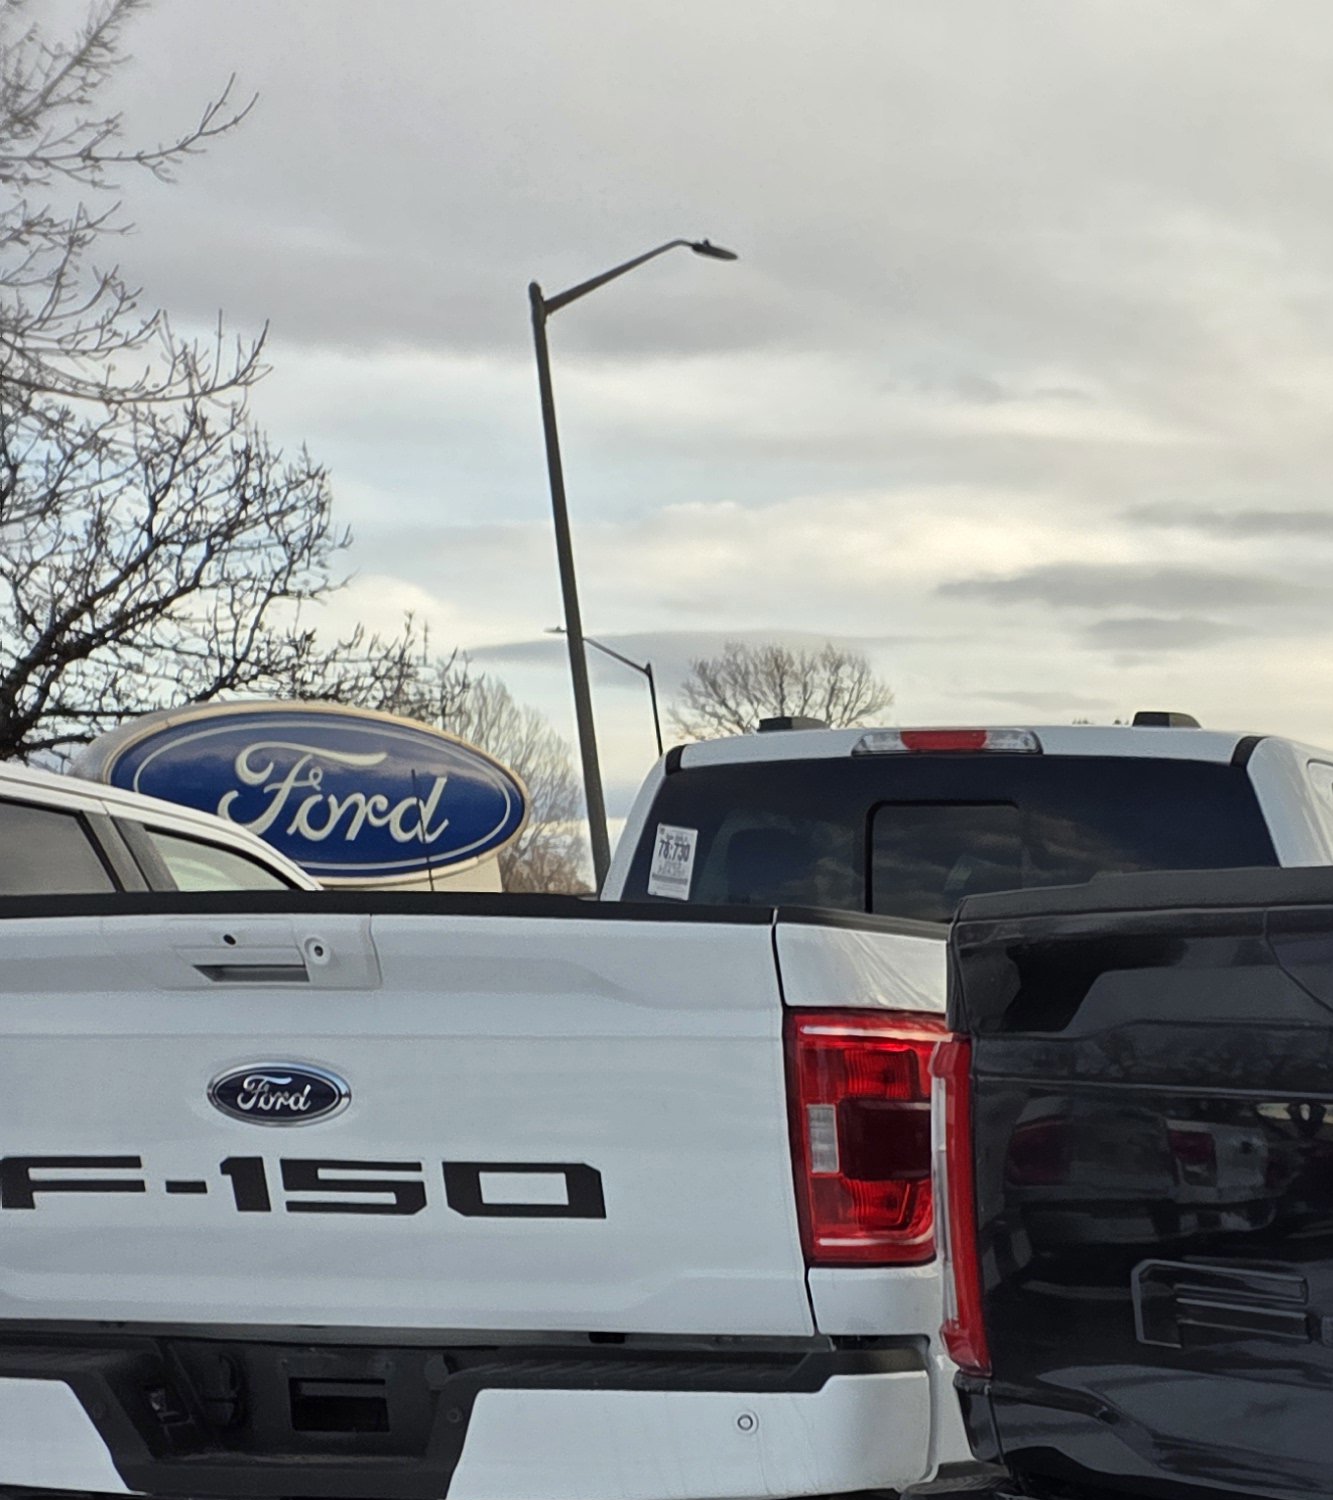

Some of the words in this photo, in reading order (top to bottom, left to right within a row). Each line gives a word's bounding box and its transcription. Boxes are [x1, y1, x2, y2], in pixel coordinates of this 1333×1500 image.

[218, 741, 450, 844] Ford
[236, 1073, 312, 1114] Ford
[0, 1154, 608, 1220] F-150
